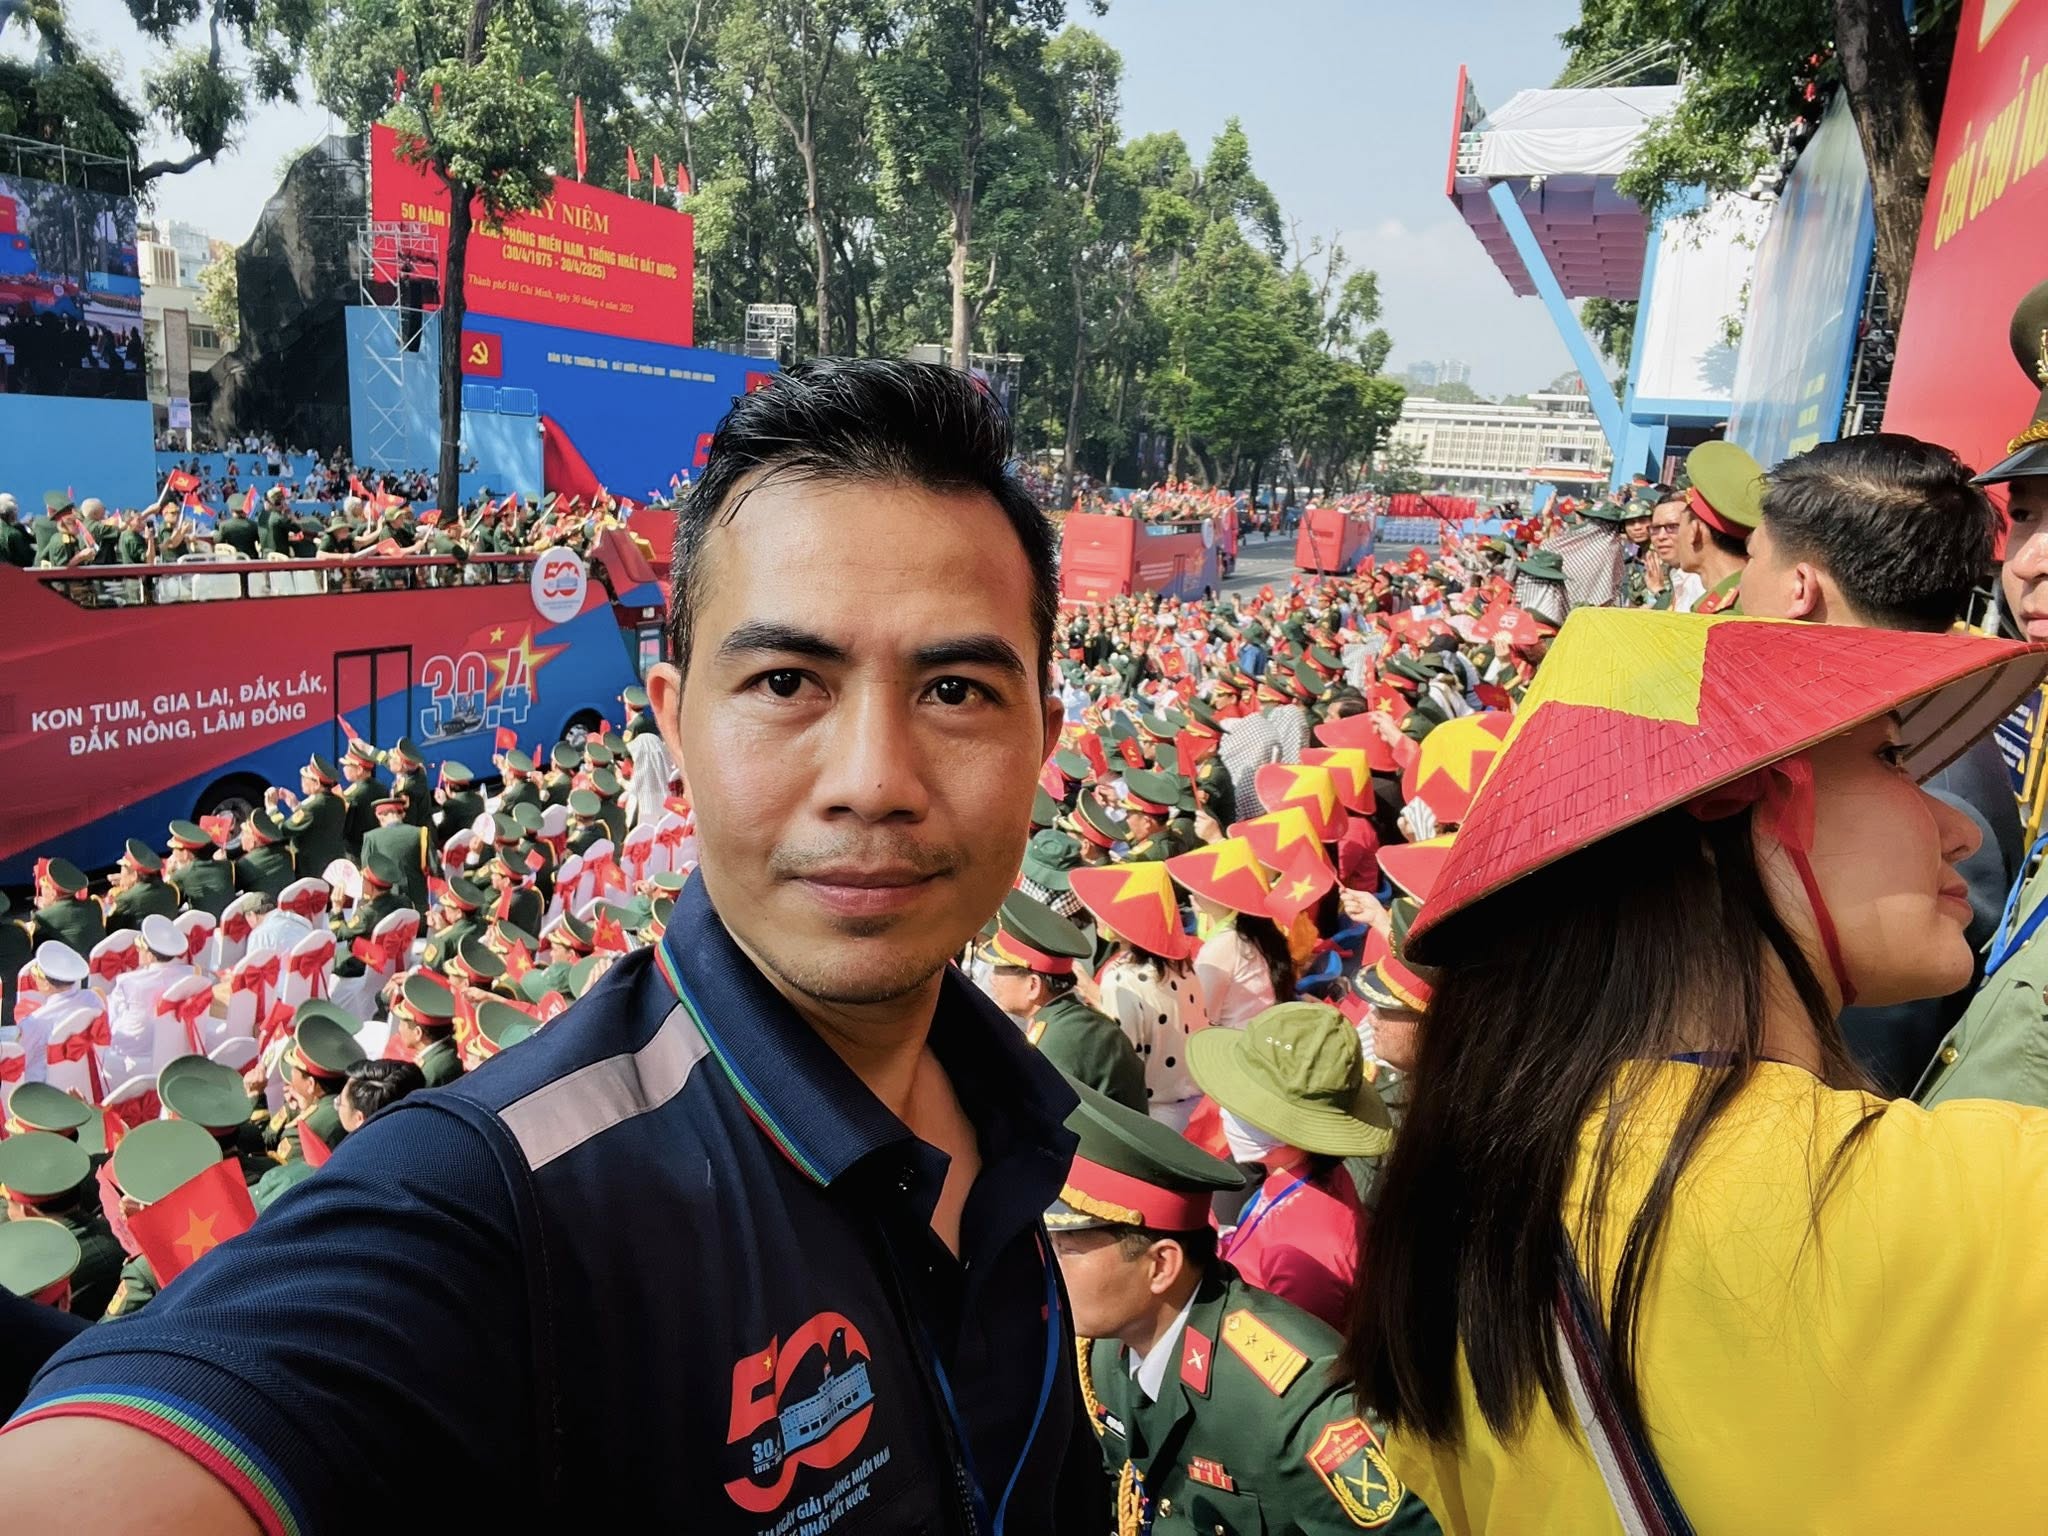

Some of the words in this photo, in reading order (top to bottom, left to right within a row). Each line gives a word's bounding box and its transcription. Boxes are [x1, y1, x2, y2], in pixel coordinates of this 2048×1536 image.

[1970, 55, 2030, 221] CHỦ
[401, 202, 416, 220] 50
[418, 204, 445, 227] NĂM
[562, 203, 609, 235] NIỆM
[502, 243, 553, 268] (30/4/1975
[560, 257, 606, 280] 30/4/2025)
[31, 707, 83, 732] KON
[90, 699, 146, 723] TUM,
[153, 694, 190, 715] GIA
[197, 687, 234, 709] LAI,
[239, 675, 281, 702] ĐẮK
[286, 670, 327, 696] LẮK,
[421, 648, 532, 739] 30.4
[69, 725, 120, 755] ĐẮK
[127, 719, 197, 746] NÔNG,
[203, 709, 245, 735] LÂM
[251, 700, 306, 727] ĐỒNG
[796, 1497, 822, 1520] GIẢI
[823, 1475, 851, 1509] PHÓNG
[851, 1459, 874, 1486] MIỀN
[873, 1446, 891, 1470] NAM
[799, 1512, 831, 1536] NHẤT
